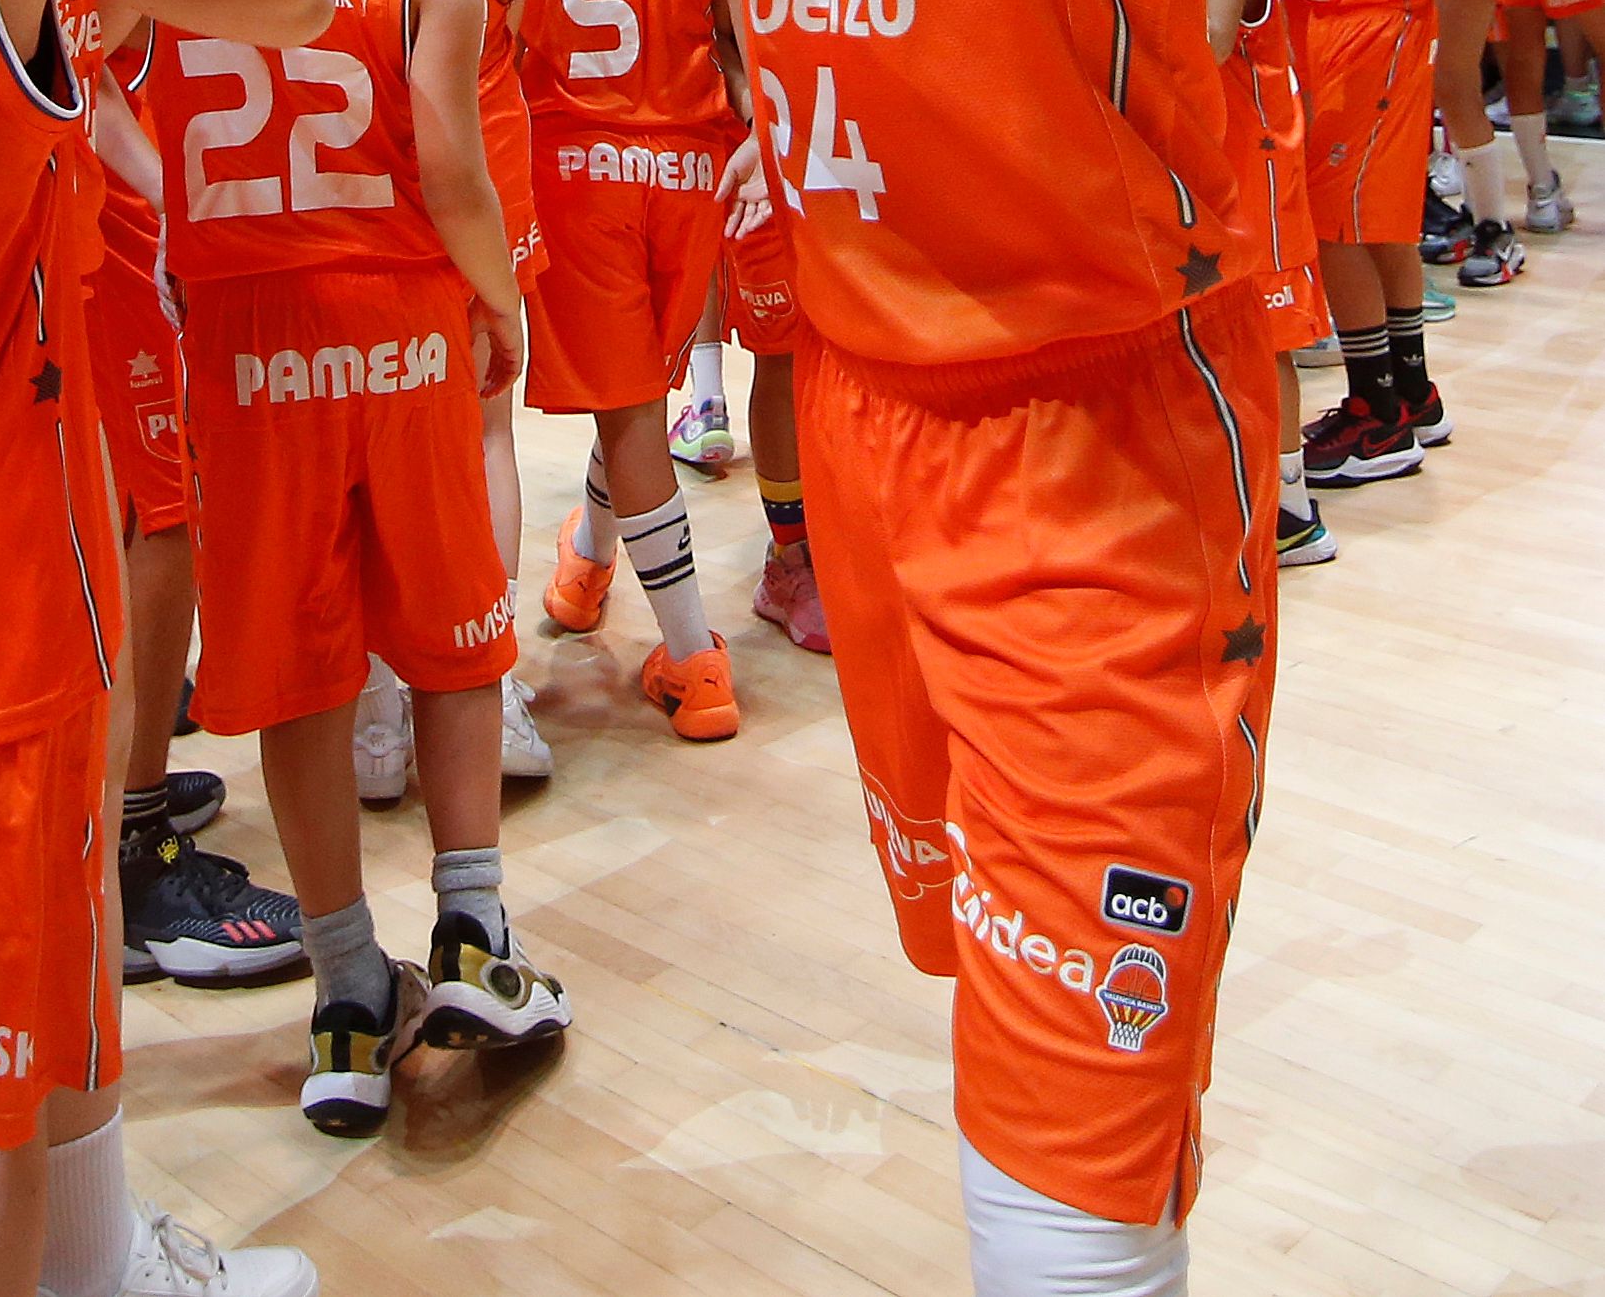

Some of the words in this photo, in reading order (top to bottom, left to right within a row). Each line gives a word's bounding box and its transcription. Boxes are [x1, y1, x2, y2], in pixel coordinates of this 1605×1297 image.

[177, 38, 396, 223] 22
[558, 143, 714, 192] PAMESA
[235, 331, 448, 407] PAMESA
[1110, 892, 1169, 925] acb
